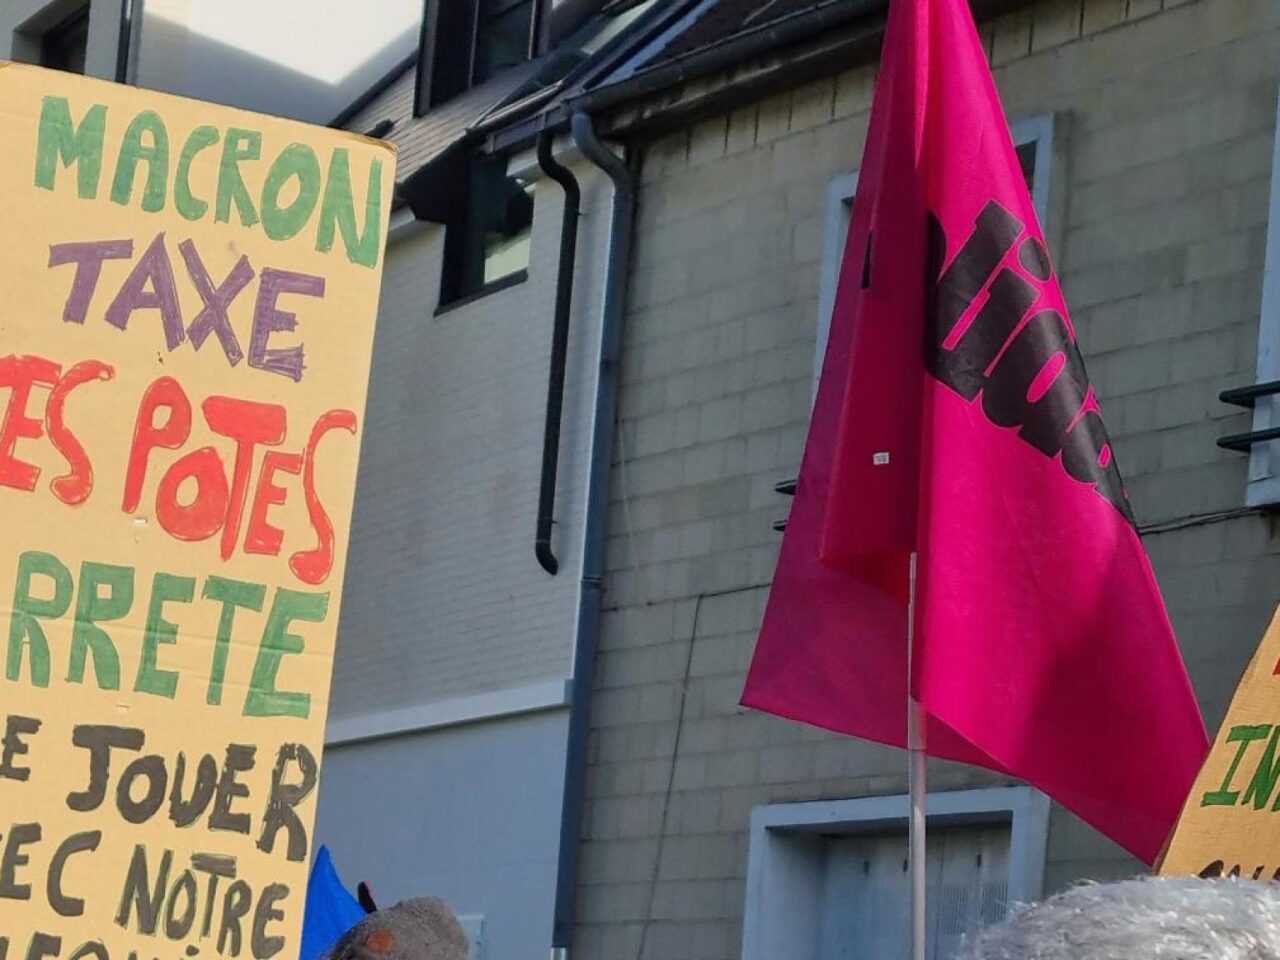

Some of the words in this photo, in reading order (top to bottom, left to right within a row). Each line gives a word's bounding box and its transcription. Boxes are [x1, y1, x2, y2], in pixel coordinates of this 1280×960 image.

[34, 95, 383, 269] MACRON
[48, 231, 326, 382] TAXE
[122, 375, 357, 584] POTES
[66, 724, 318, 862] JOUER
[114, 843, 290, 959] NOTRE
